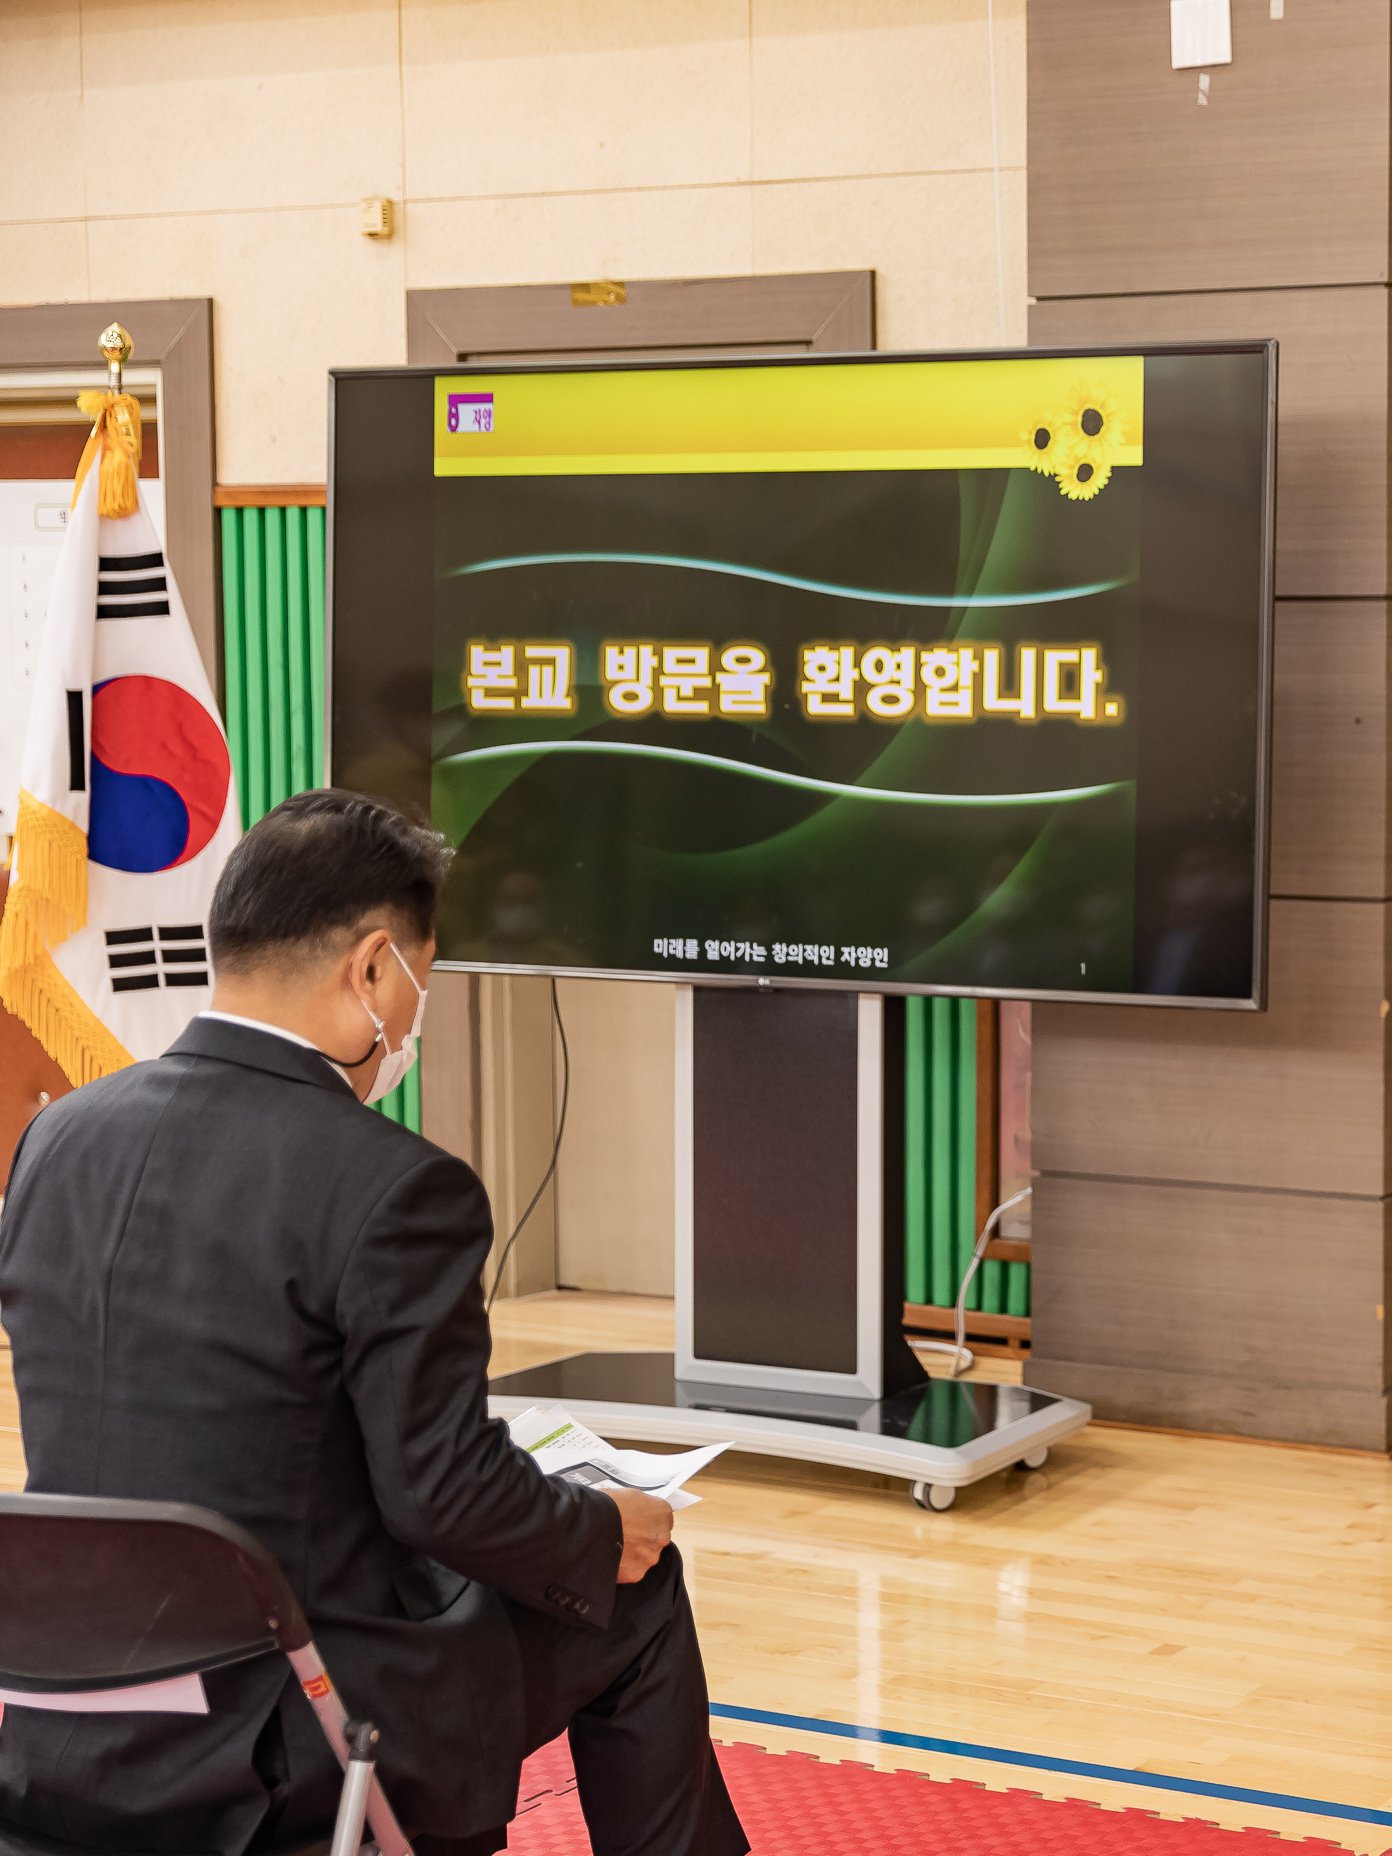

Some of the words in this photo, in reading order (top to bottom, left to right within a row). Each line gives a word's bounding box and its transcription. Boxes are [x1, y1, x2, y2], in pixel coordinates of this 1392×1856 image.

[472, 407, 491, 432] 자양
[467, 644, 572, 711] 본교
[605, 644, 770, 715] 방문을
[801, 645, 1119, 720] 환영합니다.
[653, 938, 699, 959] 미래를
[704, 939, 767, 962] 열어가는
[771, 942, 835, 966] 창의적인
[840, 945, 889, 968] 자양인
[1079, 962, 1086, 976] 1
